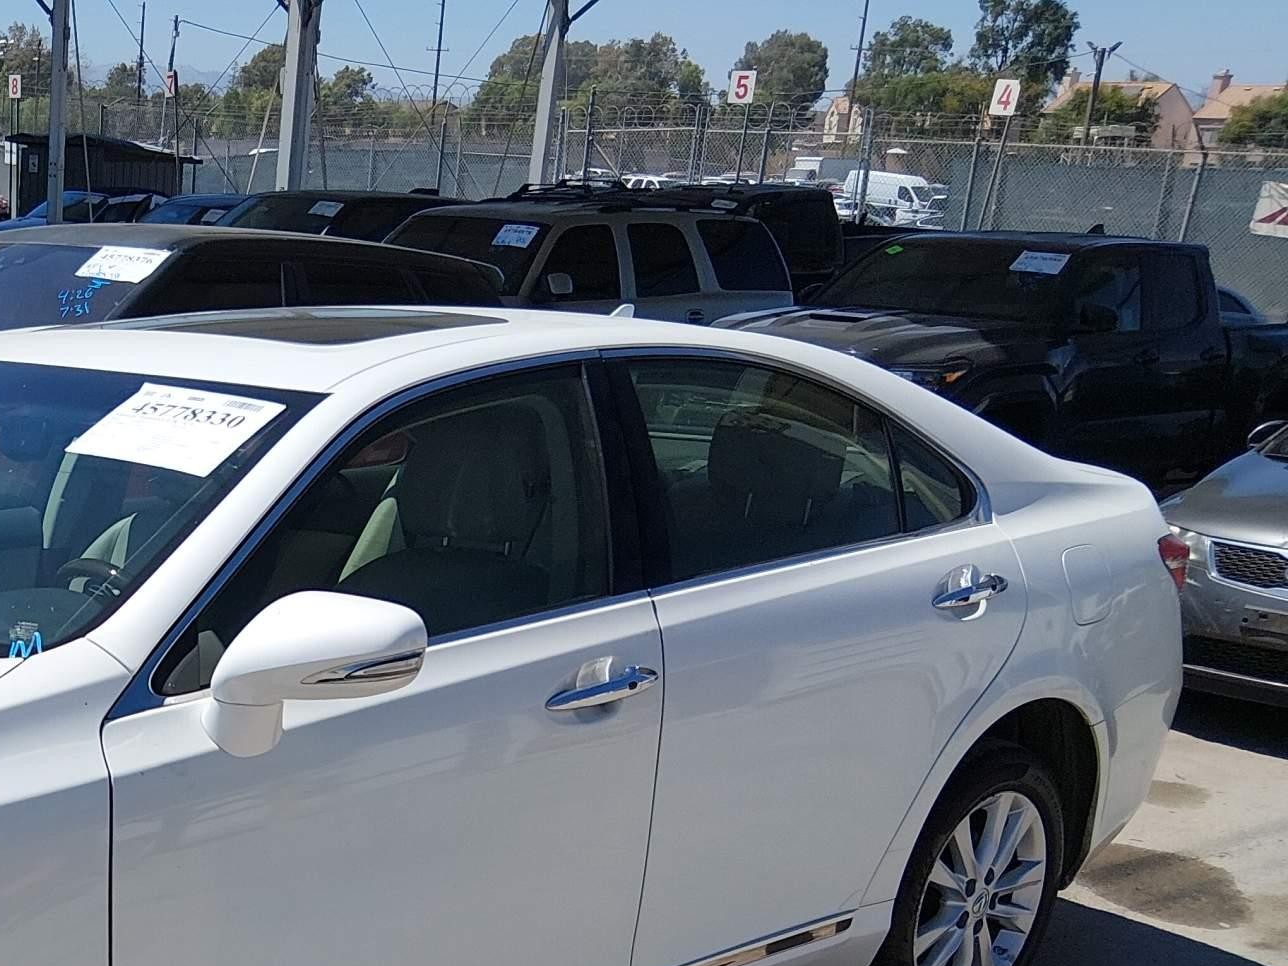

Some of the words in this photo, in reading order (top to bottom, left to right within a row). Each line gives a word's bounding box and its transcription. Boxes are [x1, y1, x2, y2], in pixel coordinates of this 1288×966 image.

[11, 78, 18, 95] 8
[166, 74, 174, 93] 7
[734, 75, 750, 99] 5
[996, 84, 1012, 110] 4
[132, 402, 246, 428] 45778330
